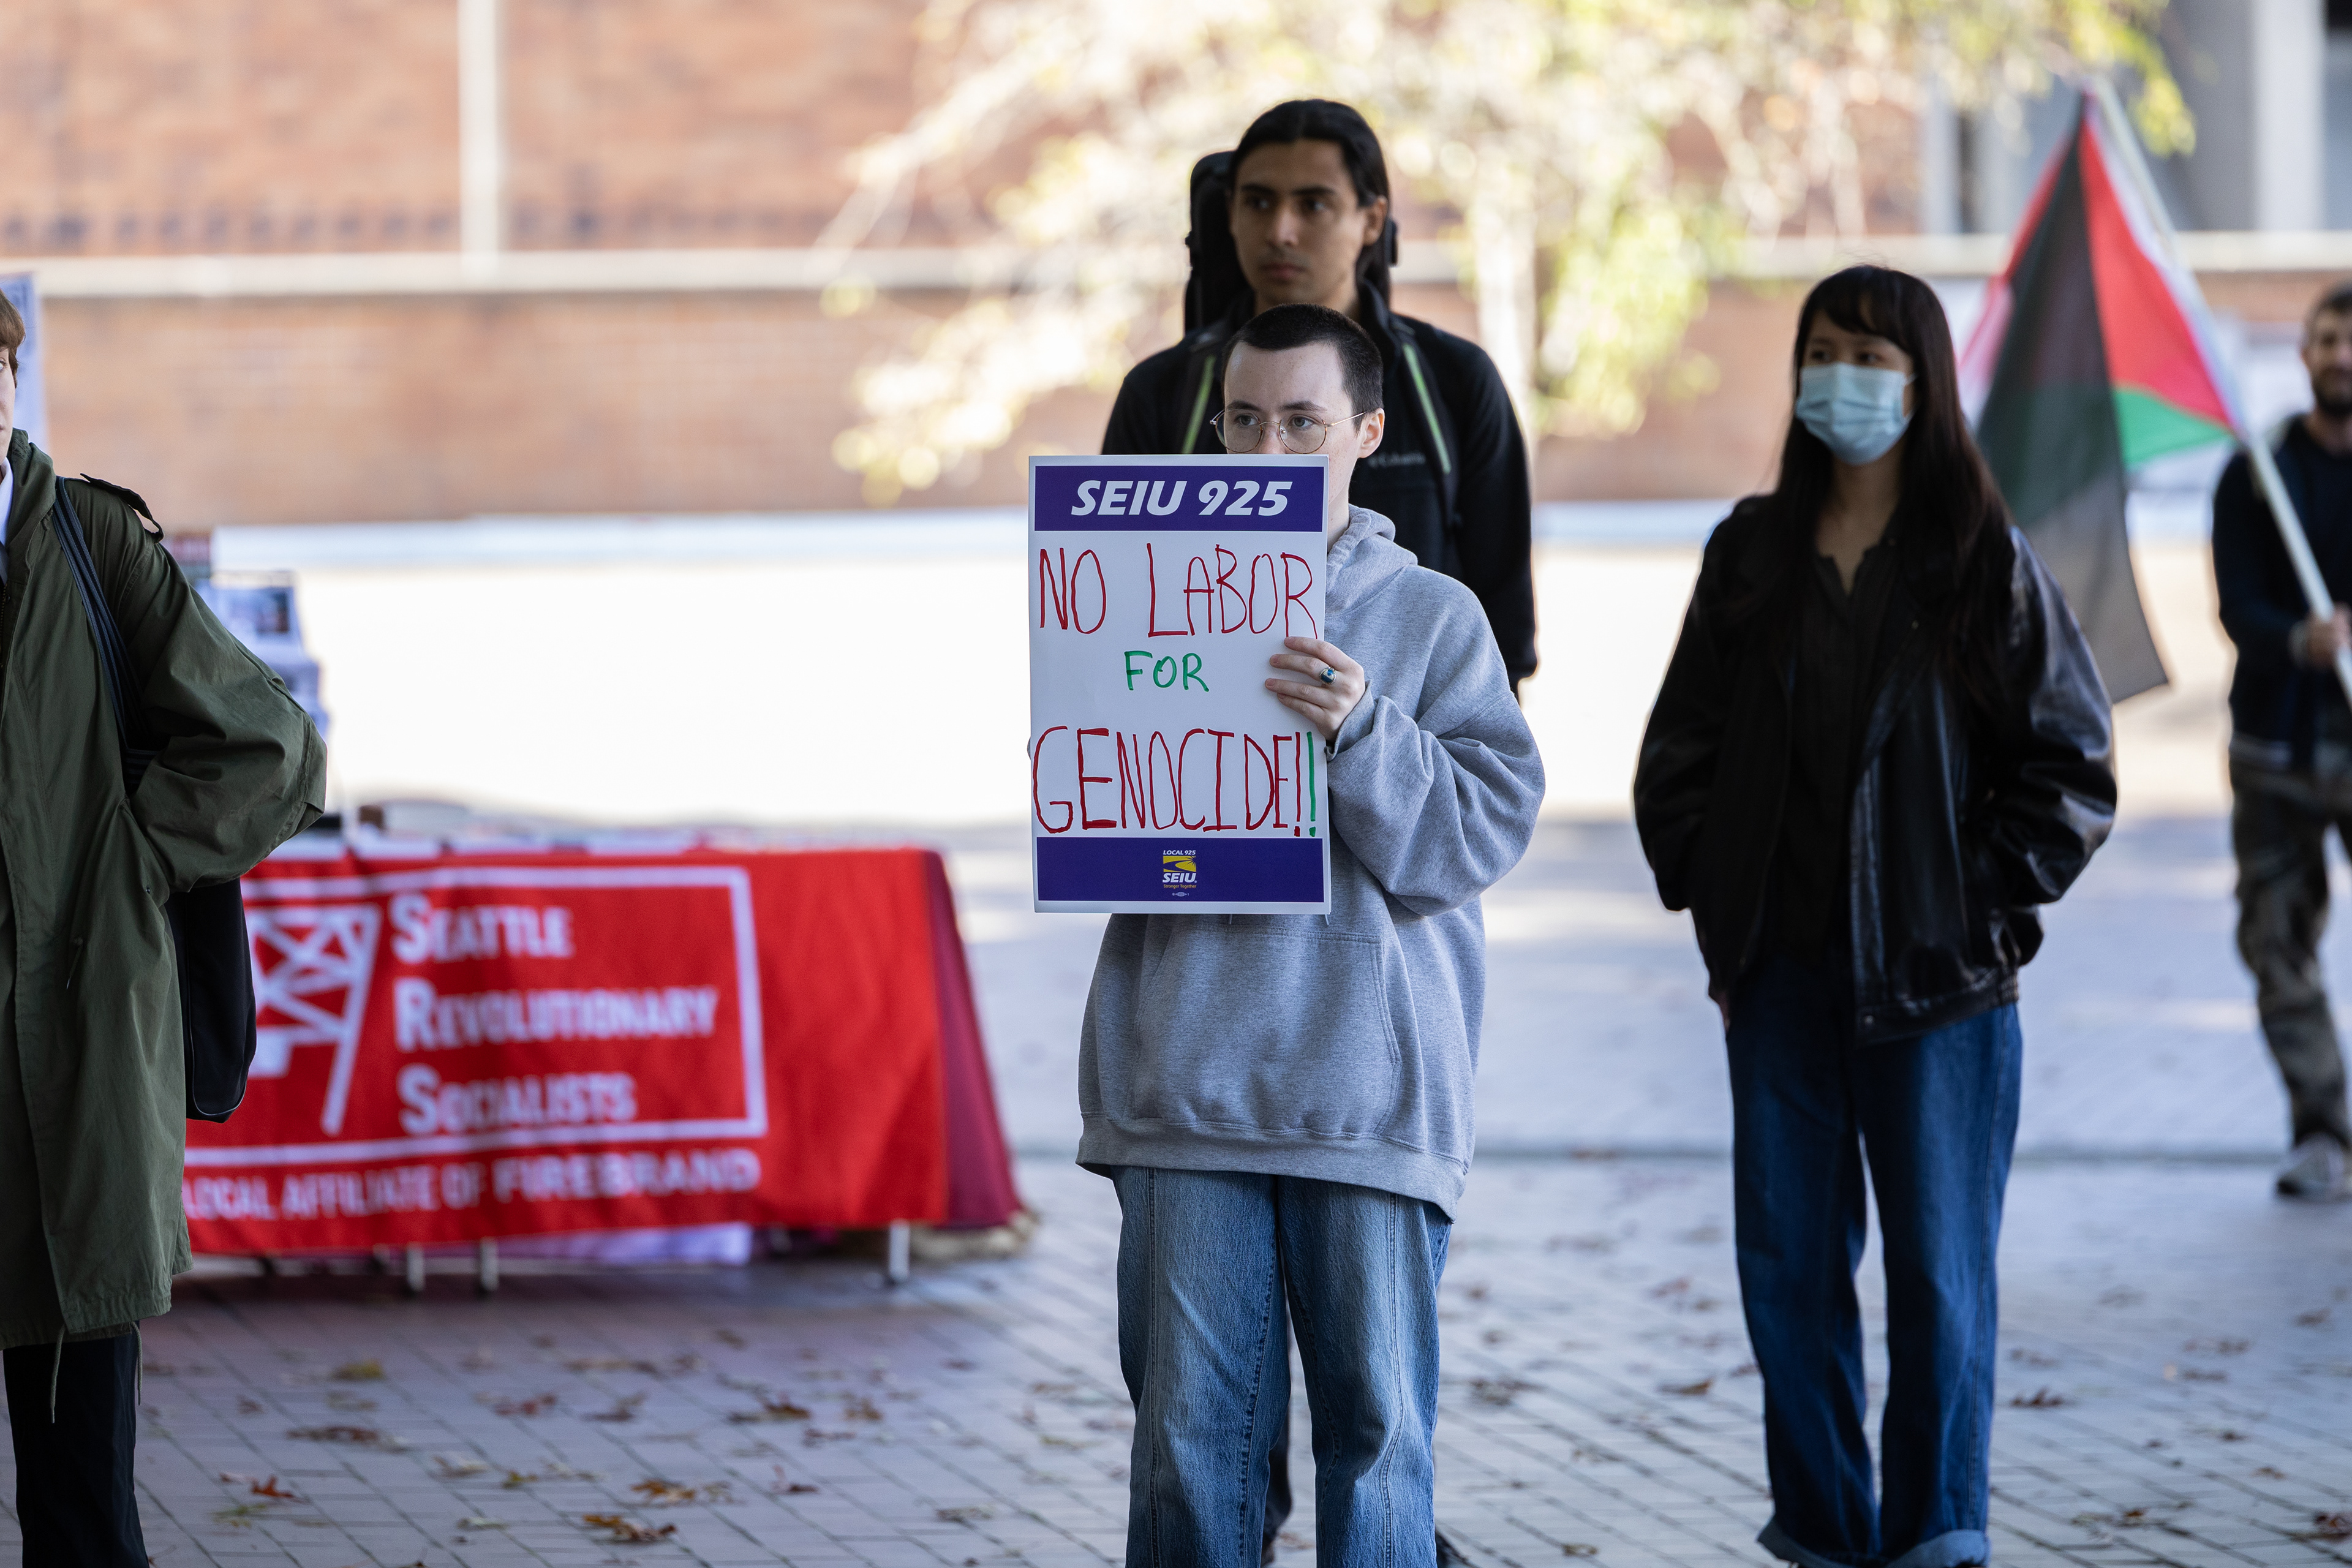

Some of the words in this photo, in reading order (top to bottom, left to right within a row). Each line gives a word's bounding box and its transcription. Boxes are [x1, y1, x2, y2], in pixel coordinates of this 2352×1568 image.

[1071, 480, 1188, 516] SEIU
[1198, 480, 1293, 516] 925
[1039, 548, 1106, 635] NO
[1146, 543, 1318, 639] LABOR
[1124, 650, 1210, 692] FOR
[1033, 725, 1316, 837] GENOCIDE!!
